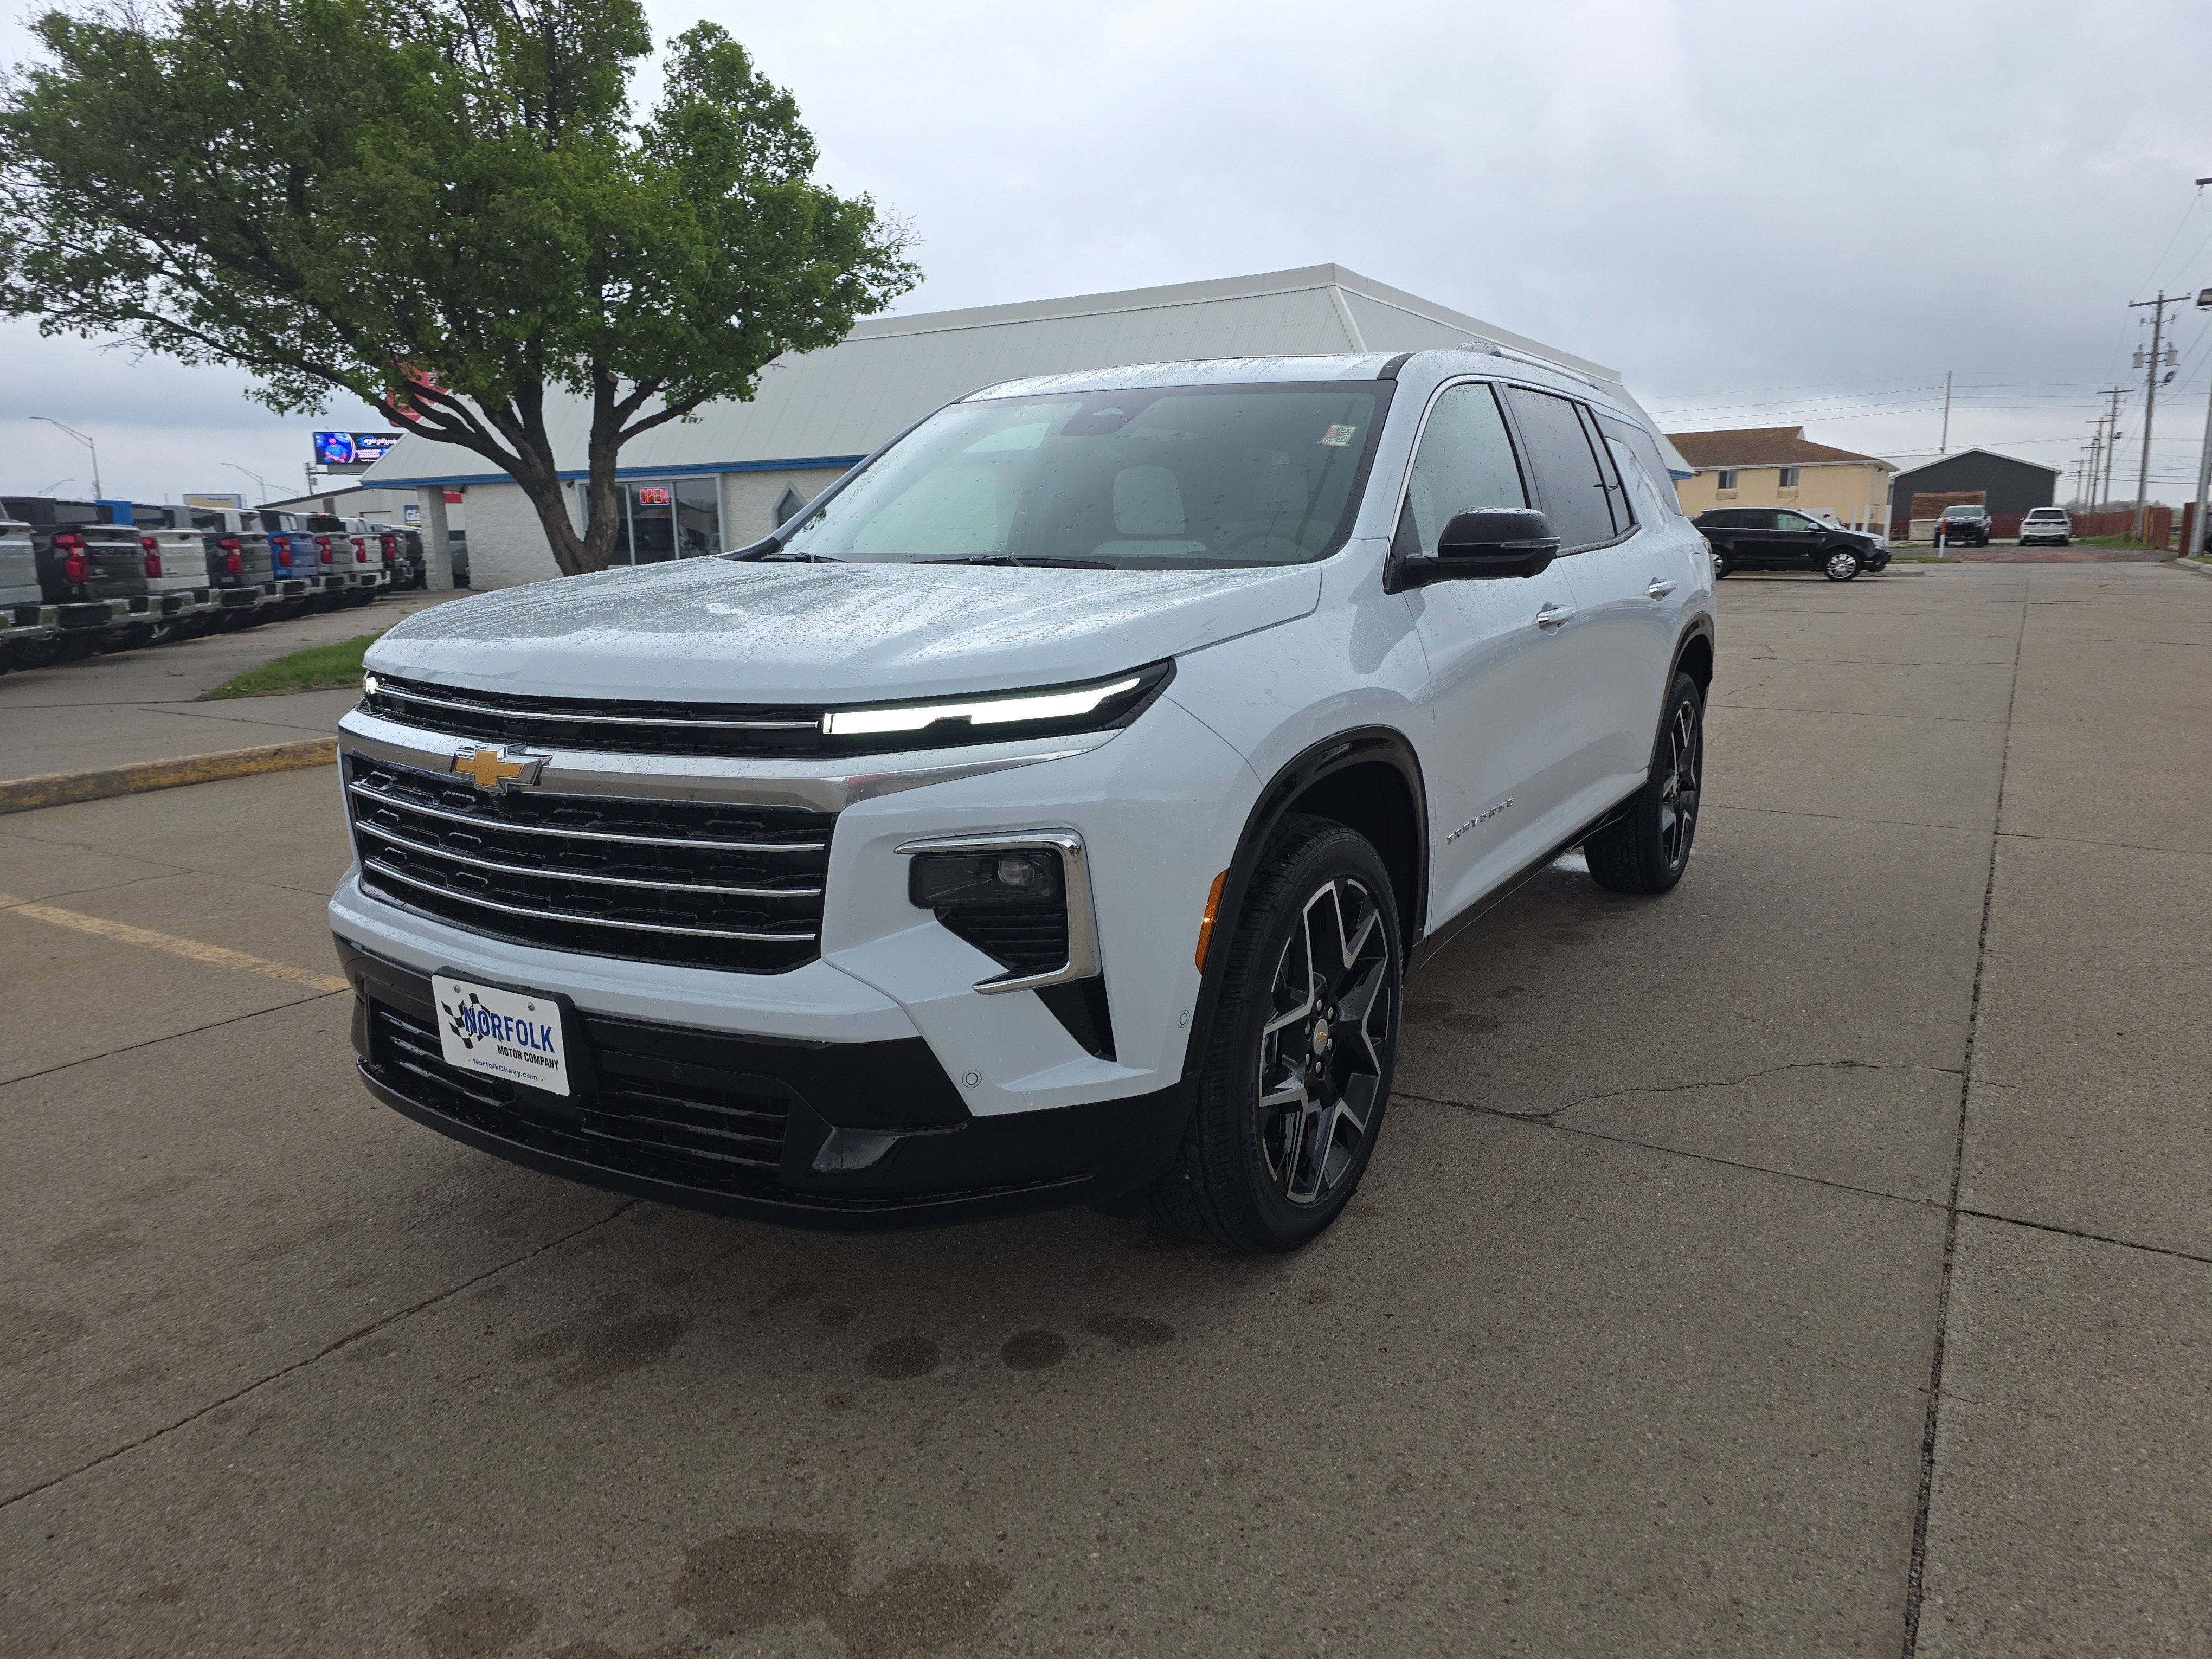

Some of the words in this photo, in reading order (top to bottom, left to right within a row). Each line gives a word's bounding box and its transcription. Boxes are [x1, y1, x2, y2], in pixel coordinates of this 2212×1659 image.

[640, 488, 670, 504] OPEN
[1447, 796, 1515, 845] TRAVERSE
[462, 1006, 556, 1053] NORFOLK
[473, 1058, 538, 1081] NorfolkChevy.com
[497, 1045, 523, 1060] MOTOR
[524, 1052, 560, 1070] COMPANY
